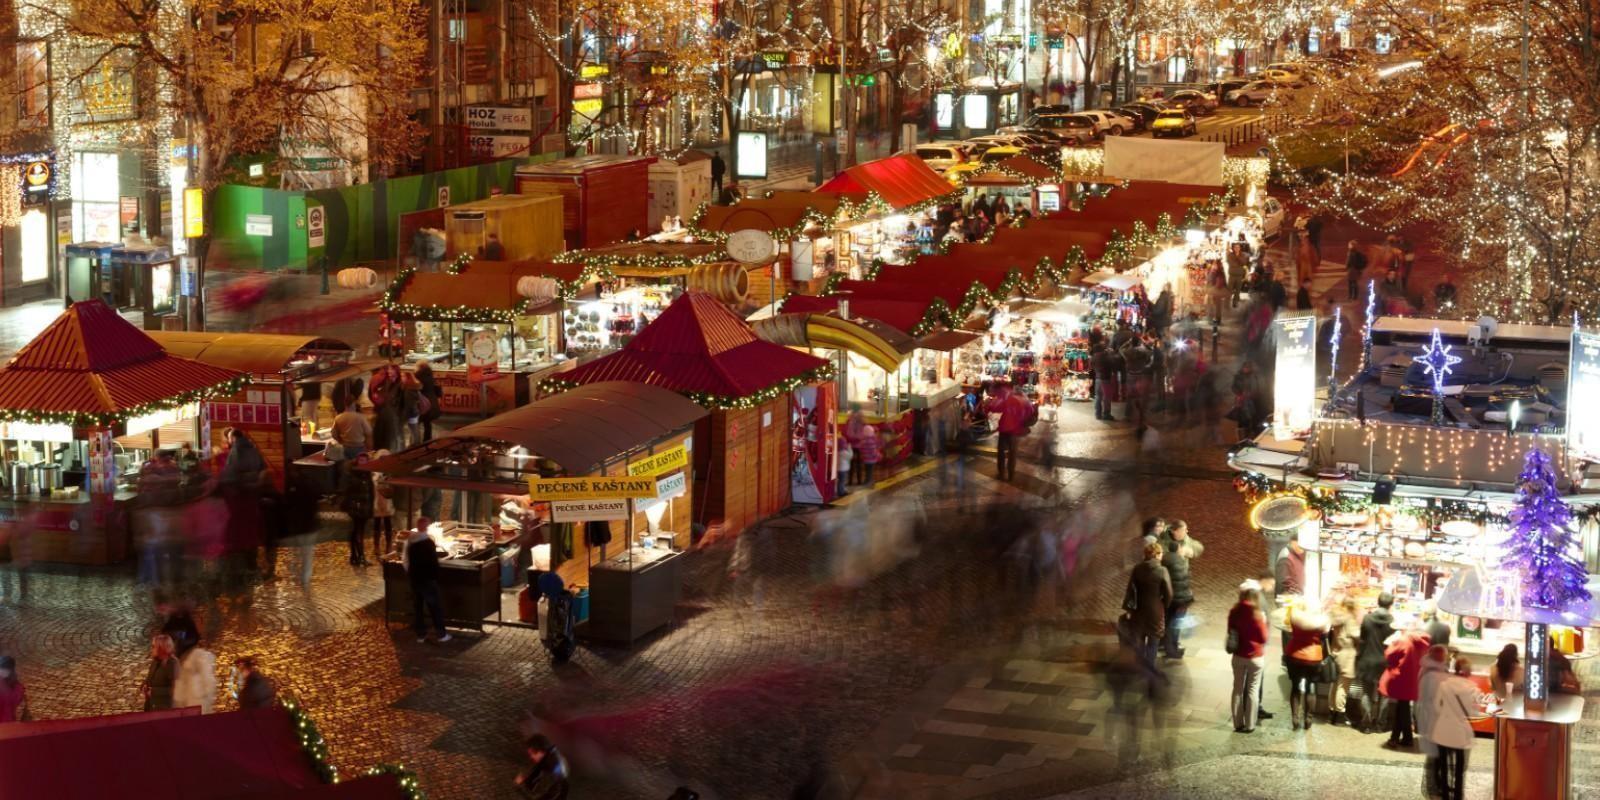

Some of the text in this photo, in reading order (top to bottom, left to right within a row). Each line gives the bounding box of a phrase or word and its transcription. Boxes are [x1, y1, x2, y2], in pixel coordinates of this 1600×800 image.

[468, 109, 496, 119] HOZ
[468, 120, 496, 128] Holub
[656, 448, 684, 468] KAŠTANY
[537, 479, 652, 493] PEČENÉ KAŠTANY
[658, 477, 684, 494] KAŠTANY
[555, 502, 625, 512] PEČENÉ KAŠTANY
[1530, 664, 1540, 700] FOOD
